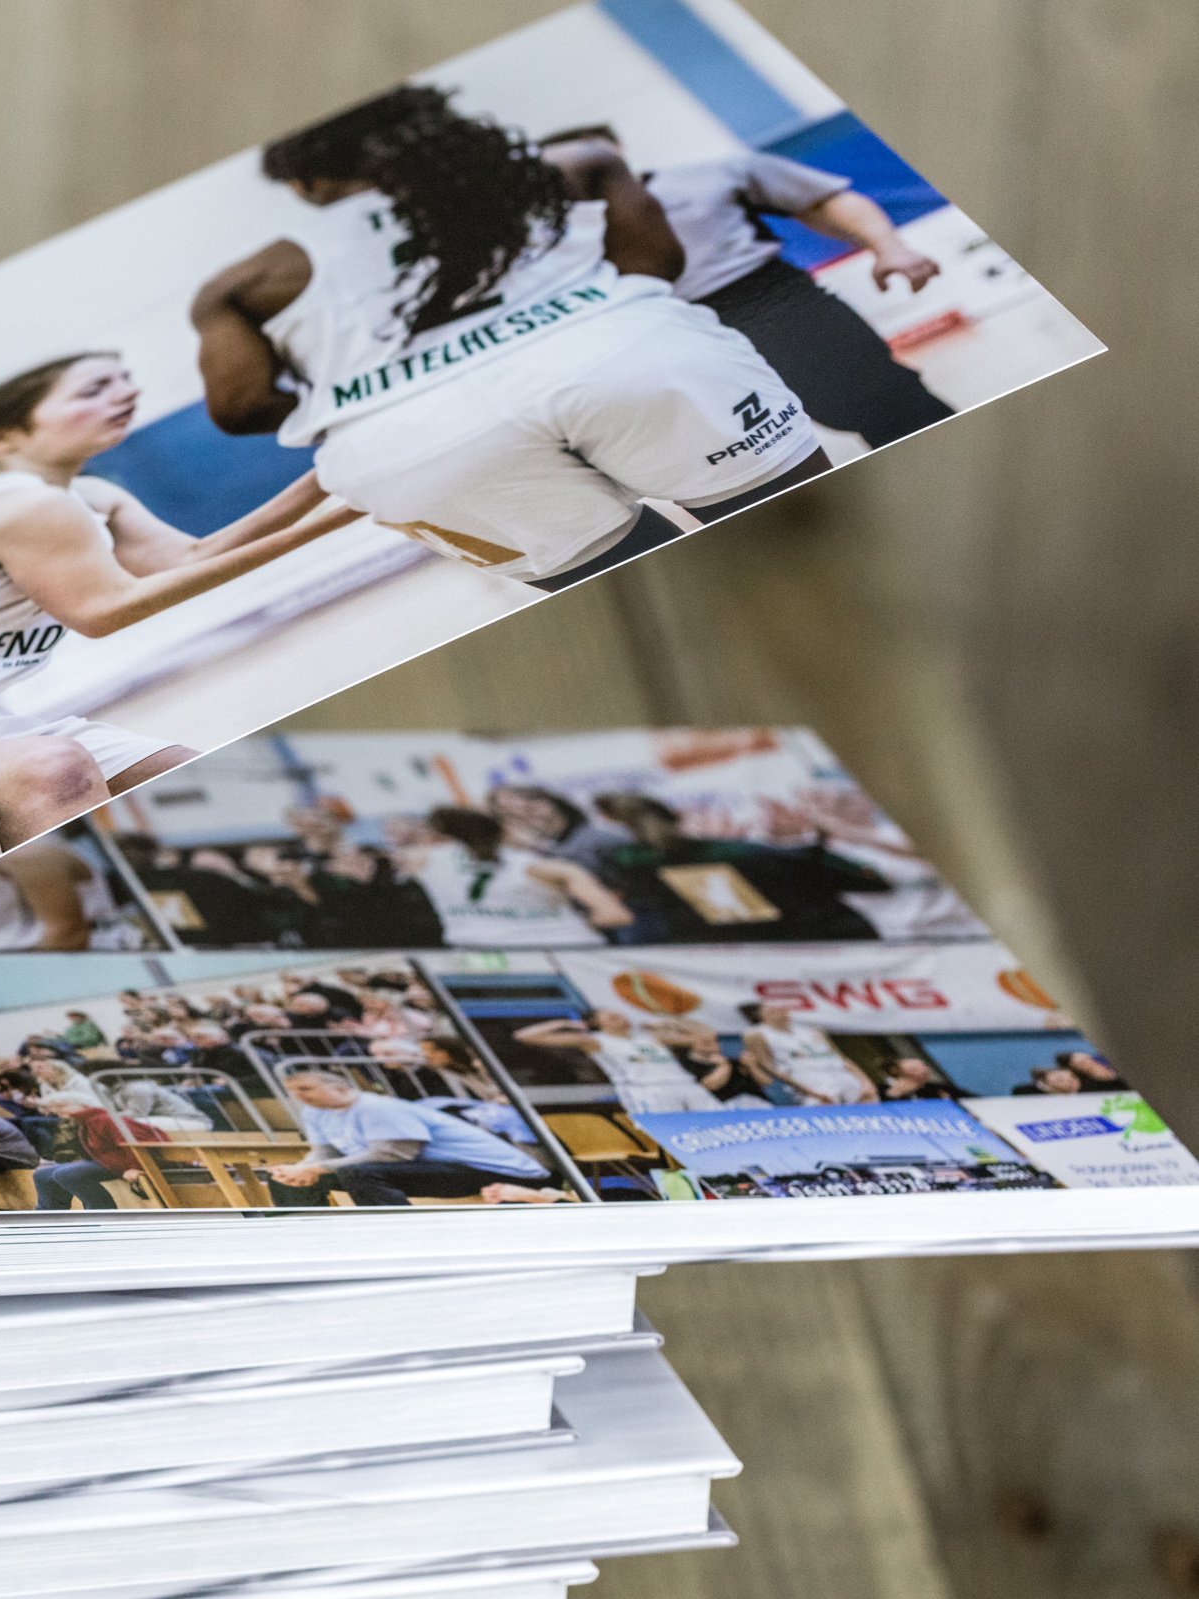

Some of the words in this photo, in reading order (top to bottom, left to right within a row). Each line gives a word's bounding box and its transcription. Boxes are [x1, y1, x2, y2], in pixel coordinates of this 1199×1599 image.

[333, 287, 607, 408] MITTELHESSEN
[706, 402, 798, 465] PRINTLINE
[754, 426, 793, 456] GIESSEN
[753, 979, 949, 1012] SWG
